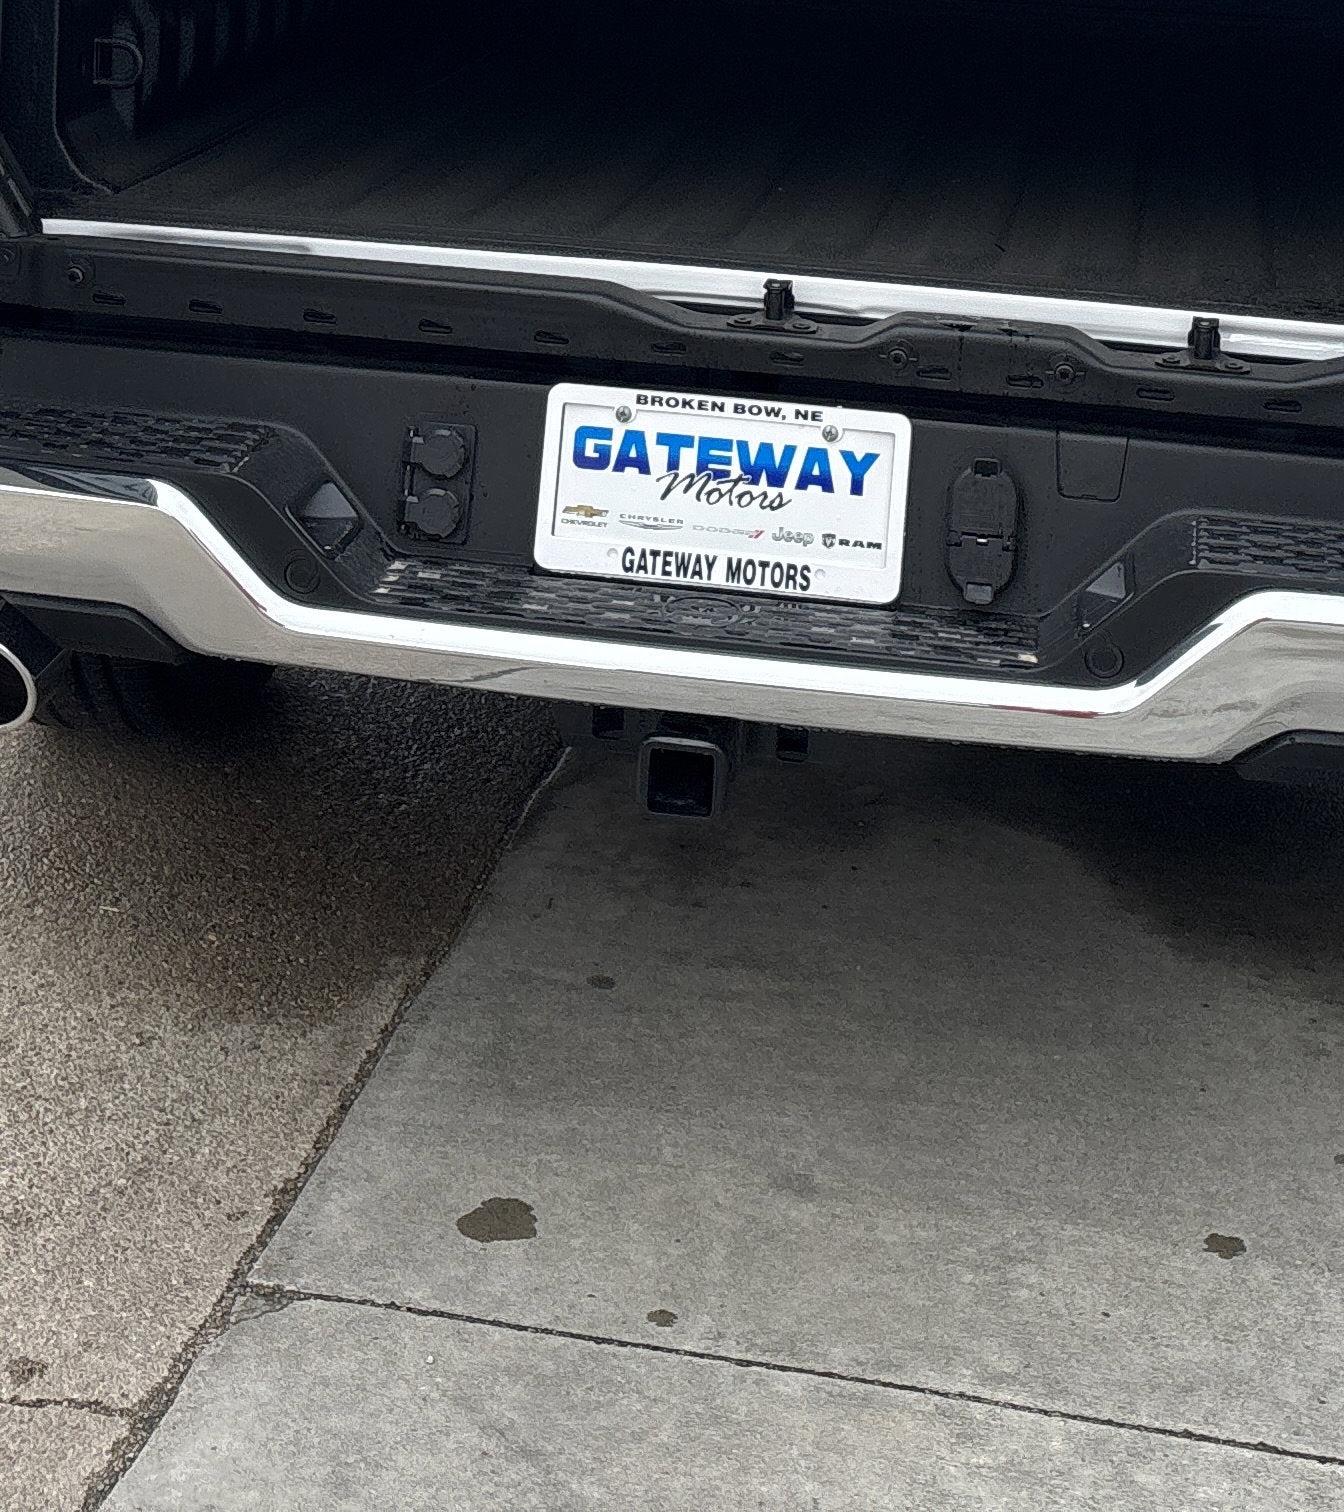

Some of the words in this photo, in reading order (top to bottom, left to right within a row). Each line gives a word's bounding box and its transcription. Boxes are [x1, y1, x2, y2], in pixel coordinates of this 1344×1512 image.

[635, 393, 726, 413] BROKEN
[732, 402, 787, 421] BOW,
[794, 408, 824, 423] NE
[571, 425, 880, 497] GATEWAY
[655, 470, 793, 512] Motors
[560, 518, 608, 528] CHEVROLET
[619, 513, 684, 525] CHRYSLER
[771, 526, 814, 547] Jeep
[838, 538, 882, 550] RAM
[621, 546, 718, 581] GATEWAY
[725, 556, 811, 592] MOTORS
